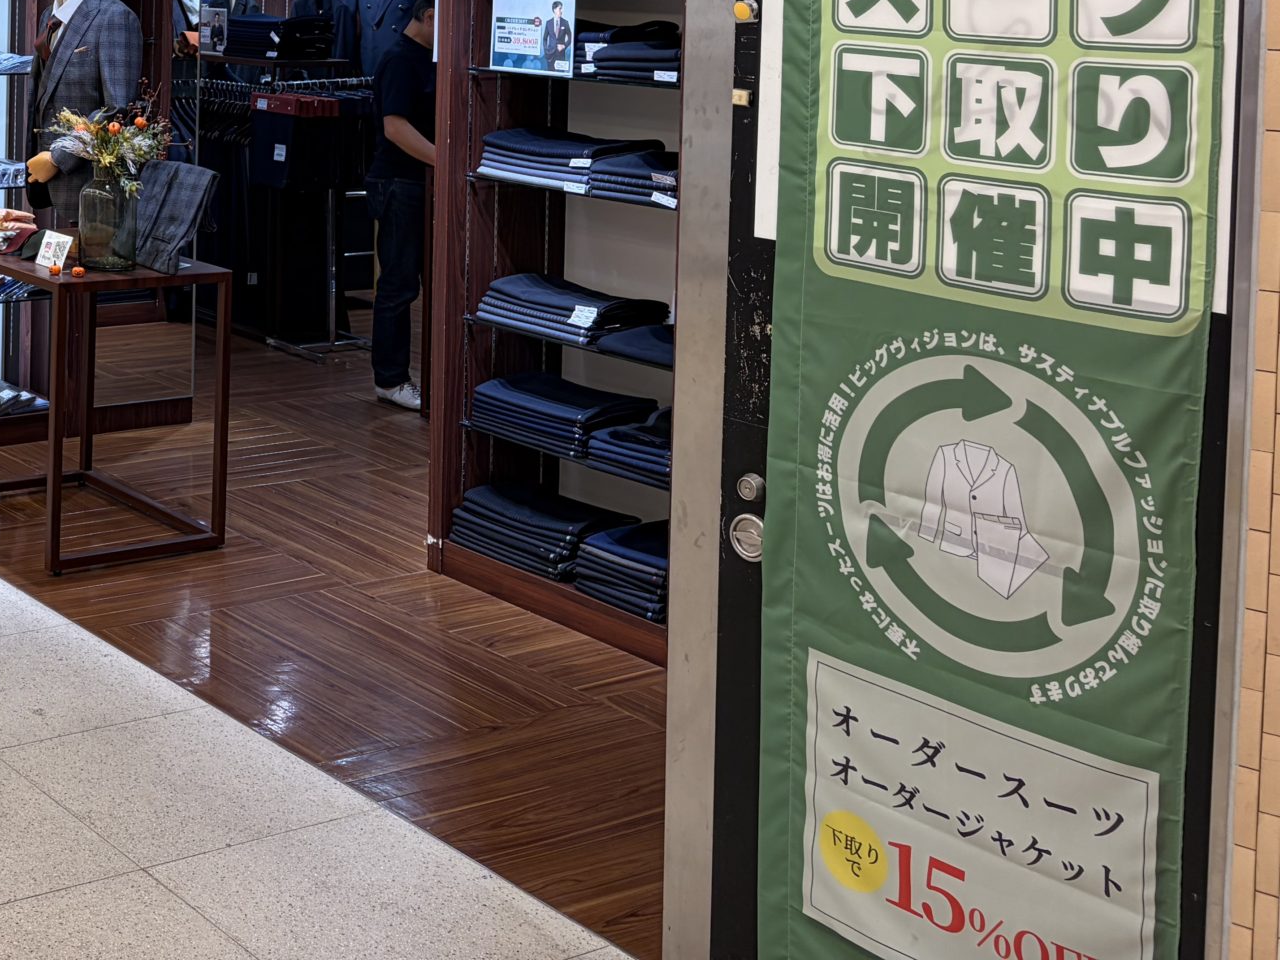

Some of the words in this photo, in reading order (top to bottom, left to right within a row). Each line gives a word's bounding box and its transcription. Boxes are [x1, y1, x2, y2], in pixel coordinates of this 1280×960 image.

[841, 52, 1172, 169] 下取り
[836, 170, 1173, 307] 開催中
[829, 755, 1123, 900] オーダージャケット
[831, 705, 1125, 838] オーダースーツ
[824, 823, 879, 865] 下取り
[844, 858, 862, 878] で
[885, 841, 1099, 960] 15%O
